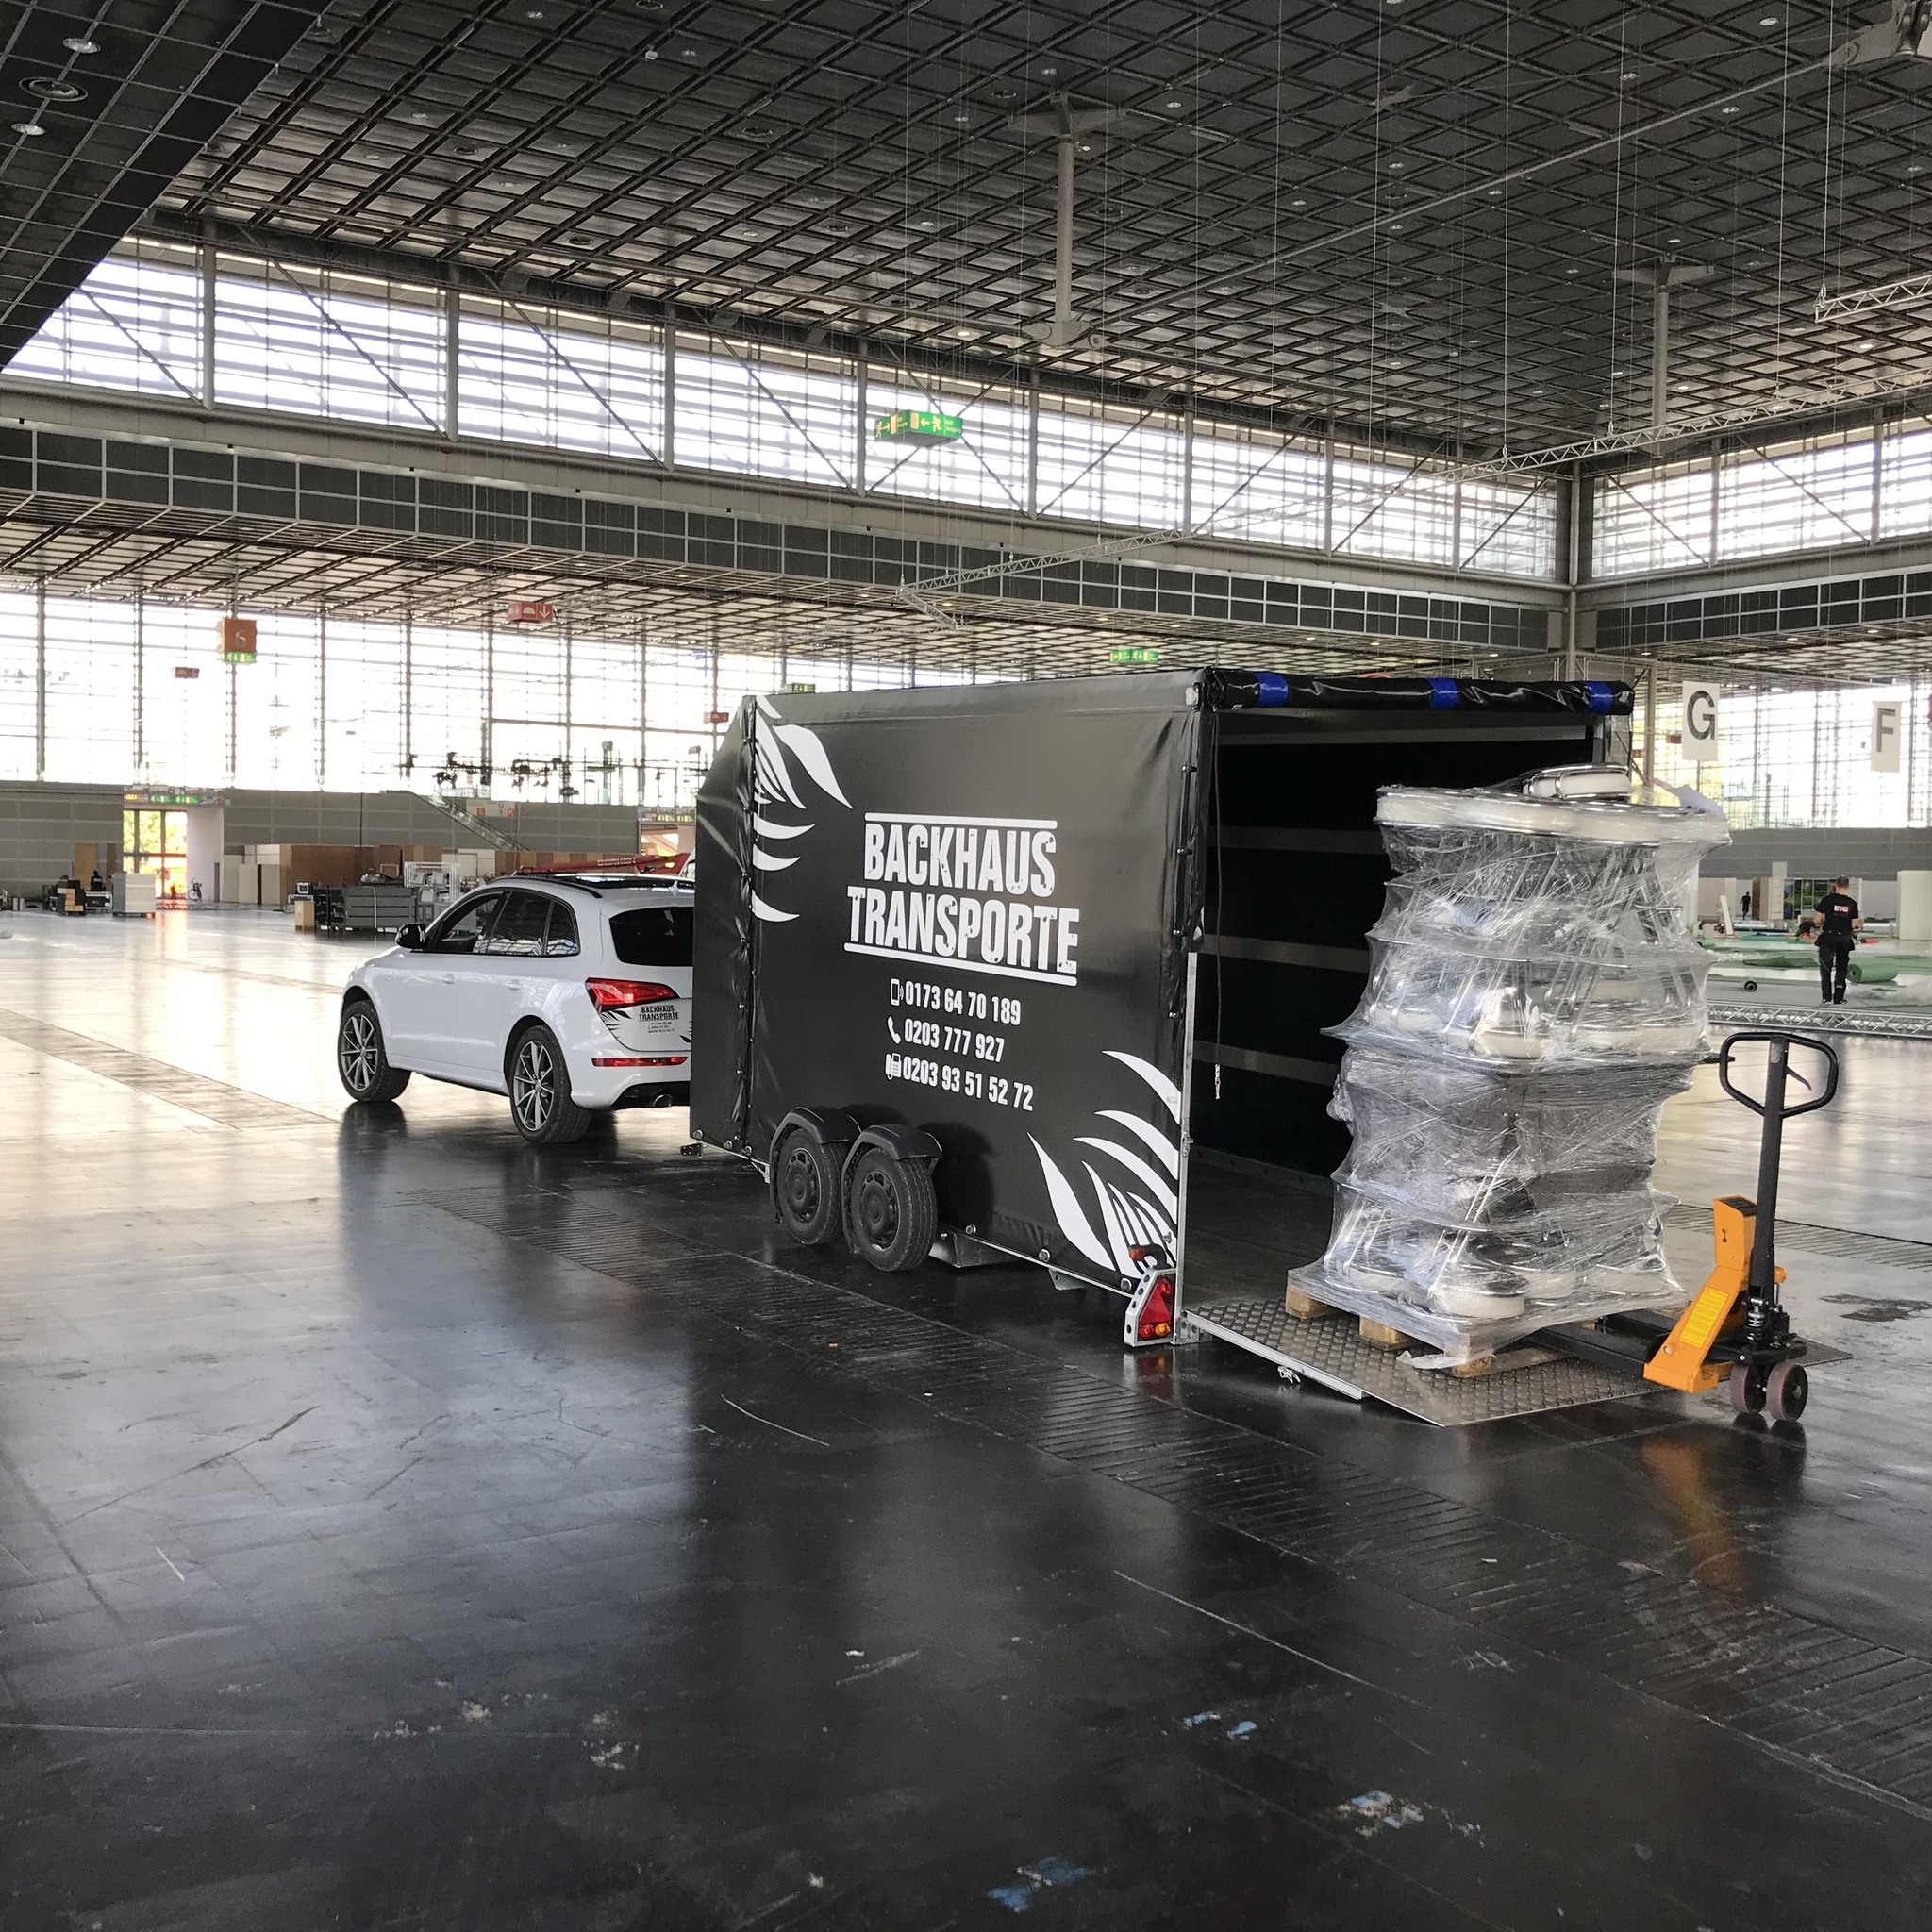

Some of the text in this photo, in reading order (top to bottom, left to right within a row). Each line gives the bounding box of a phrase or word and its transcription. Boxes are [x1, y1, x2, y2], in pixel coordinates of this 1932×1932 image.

[1687, 690, 1716, 741] G
[1876, 708, 1896, 753] F
[864, 823, 1058, 898] BACKHAUS
[847, 886, 1080, 974] TRANSPORTE
[638, 1012, 679, 1021] TRANSPORTE
[641, 1005, 675, 1014] BACKHAUS
[904, 979, 1022, 1026] 0173 64 70 189
[903, 1017, 1005, 1063] 0203 777 927
[902, 1053, 1034, 1112] 0203 93 51 52 72
